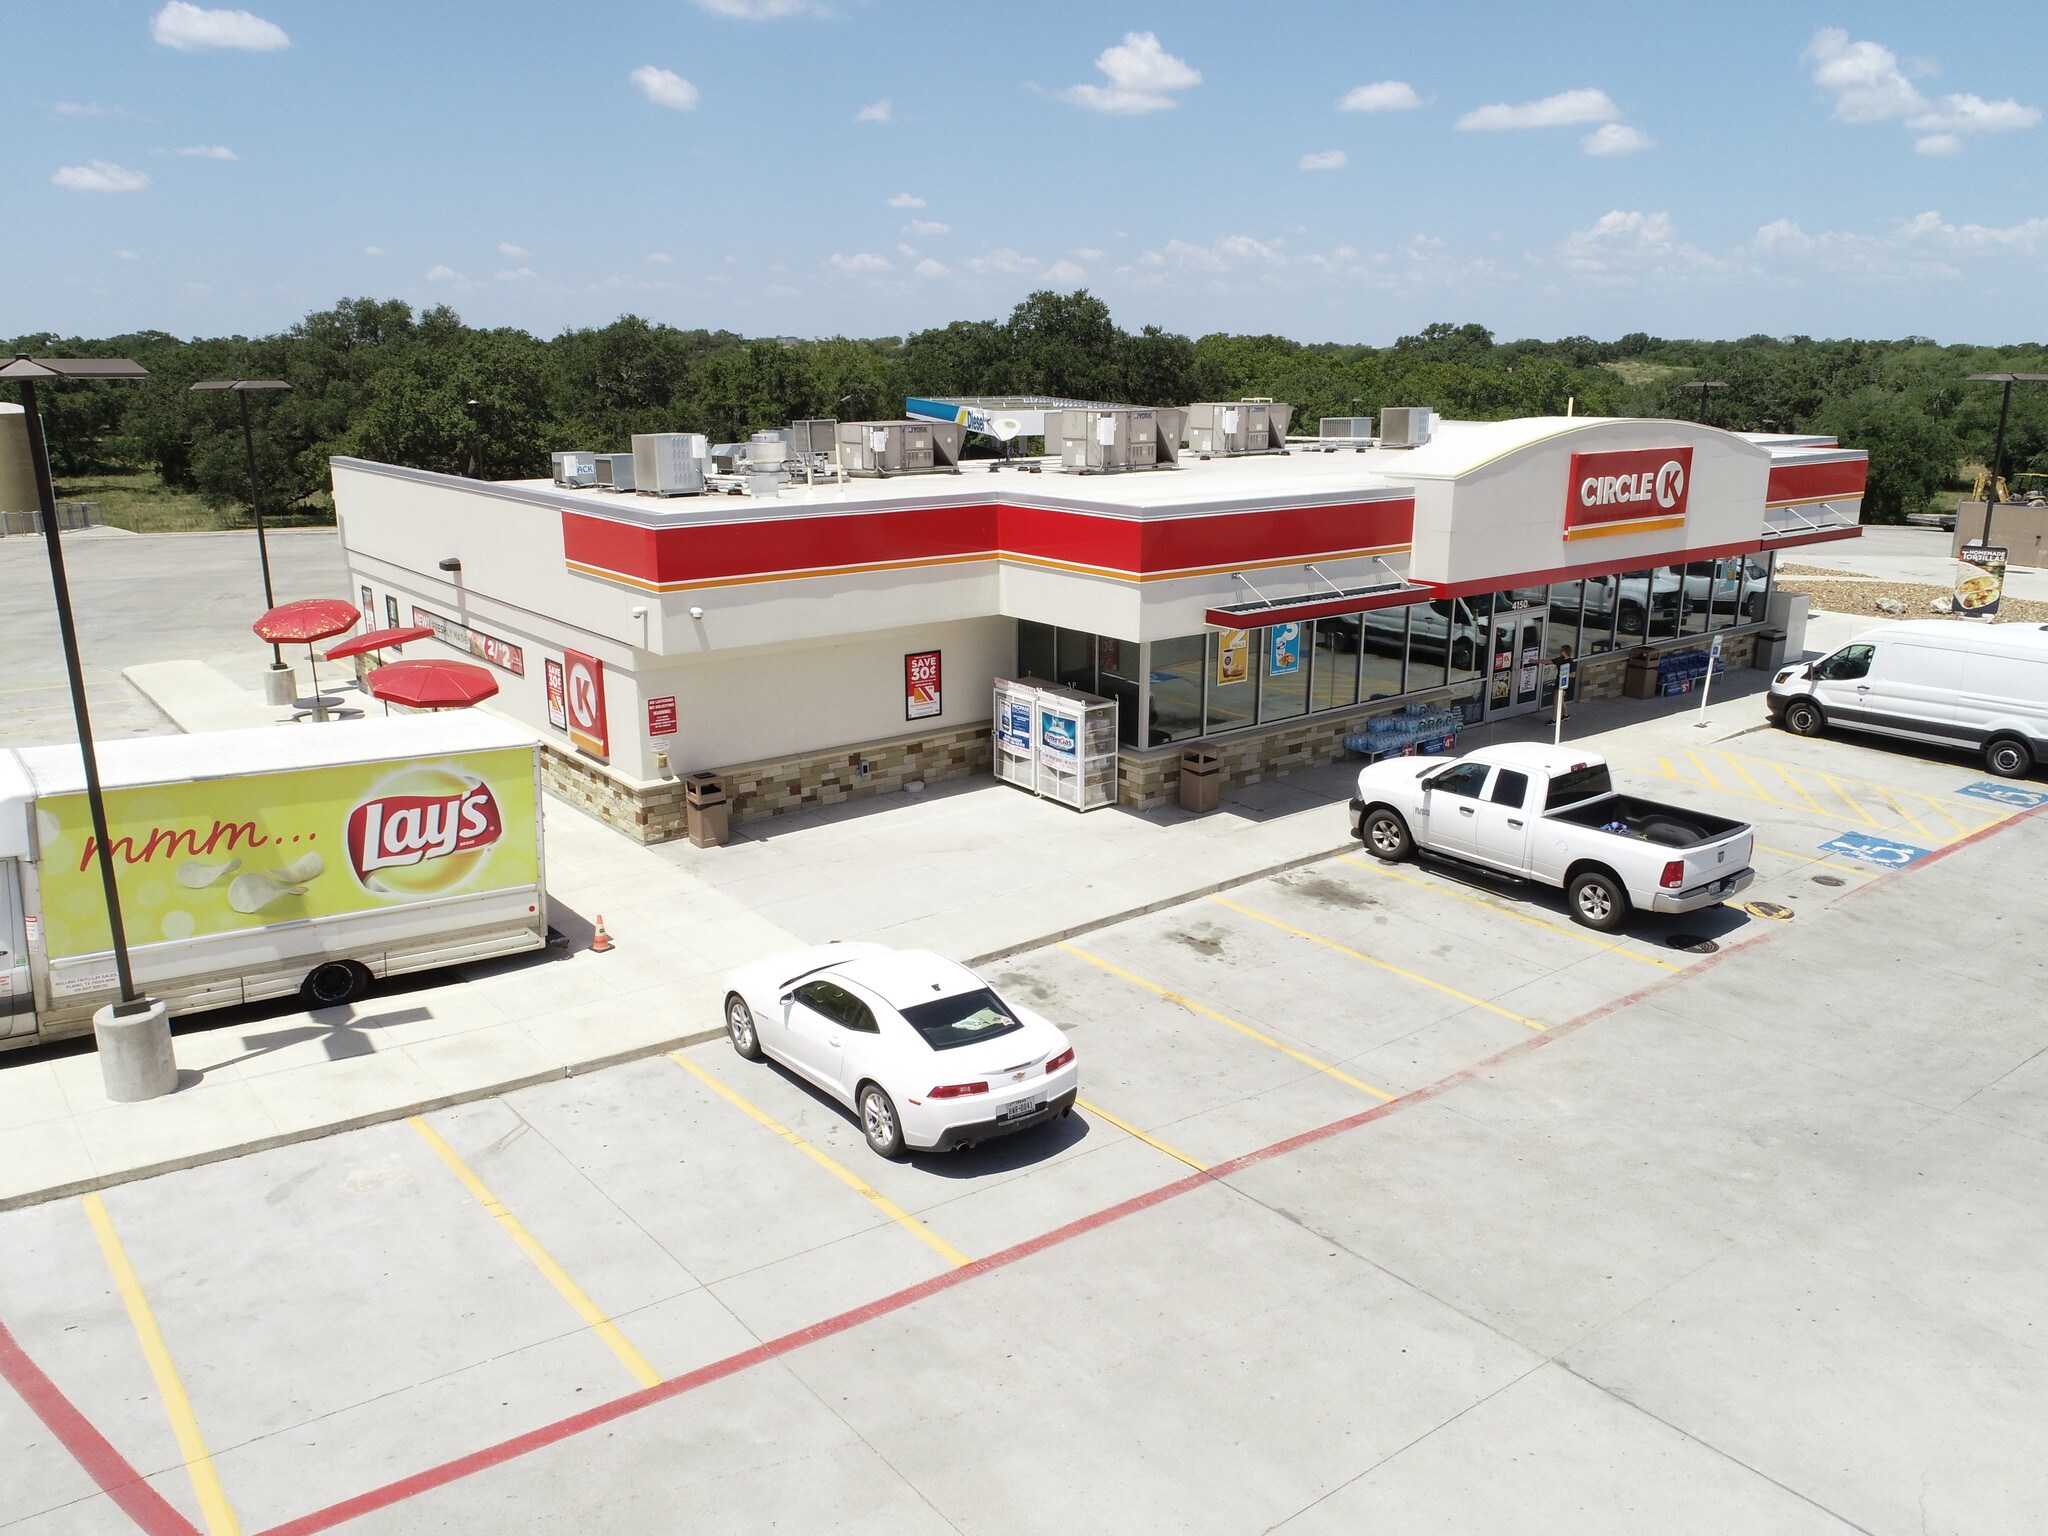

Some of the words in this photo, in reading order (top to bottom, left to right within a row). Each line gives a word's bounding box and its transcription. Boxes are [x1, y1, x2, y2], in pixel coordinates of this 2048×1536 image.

[967, 410, 984, 432] Diesel
[577, 465, 593, 473] ACK
[1581, 473, 1654, 507] CIRCLE
[1659, 465, 1682, 506] K
[1962, 551, 2006, 562] TORTILLAS
[1968, 549, 2006, 557] HOMEMADE
[1511, 600, 1528, 610] 4150
[414, 611, 430, 629] NEW!
[452, 630, 469, 646] MADE
[911, 657, 936, 668] SAVE
[549, 664, 561, 677] SAVE
[911, 665, 936, 681] 30¢
[572, 668, 596, 727] K
[362, 791, 488, 872] Lay's
